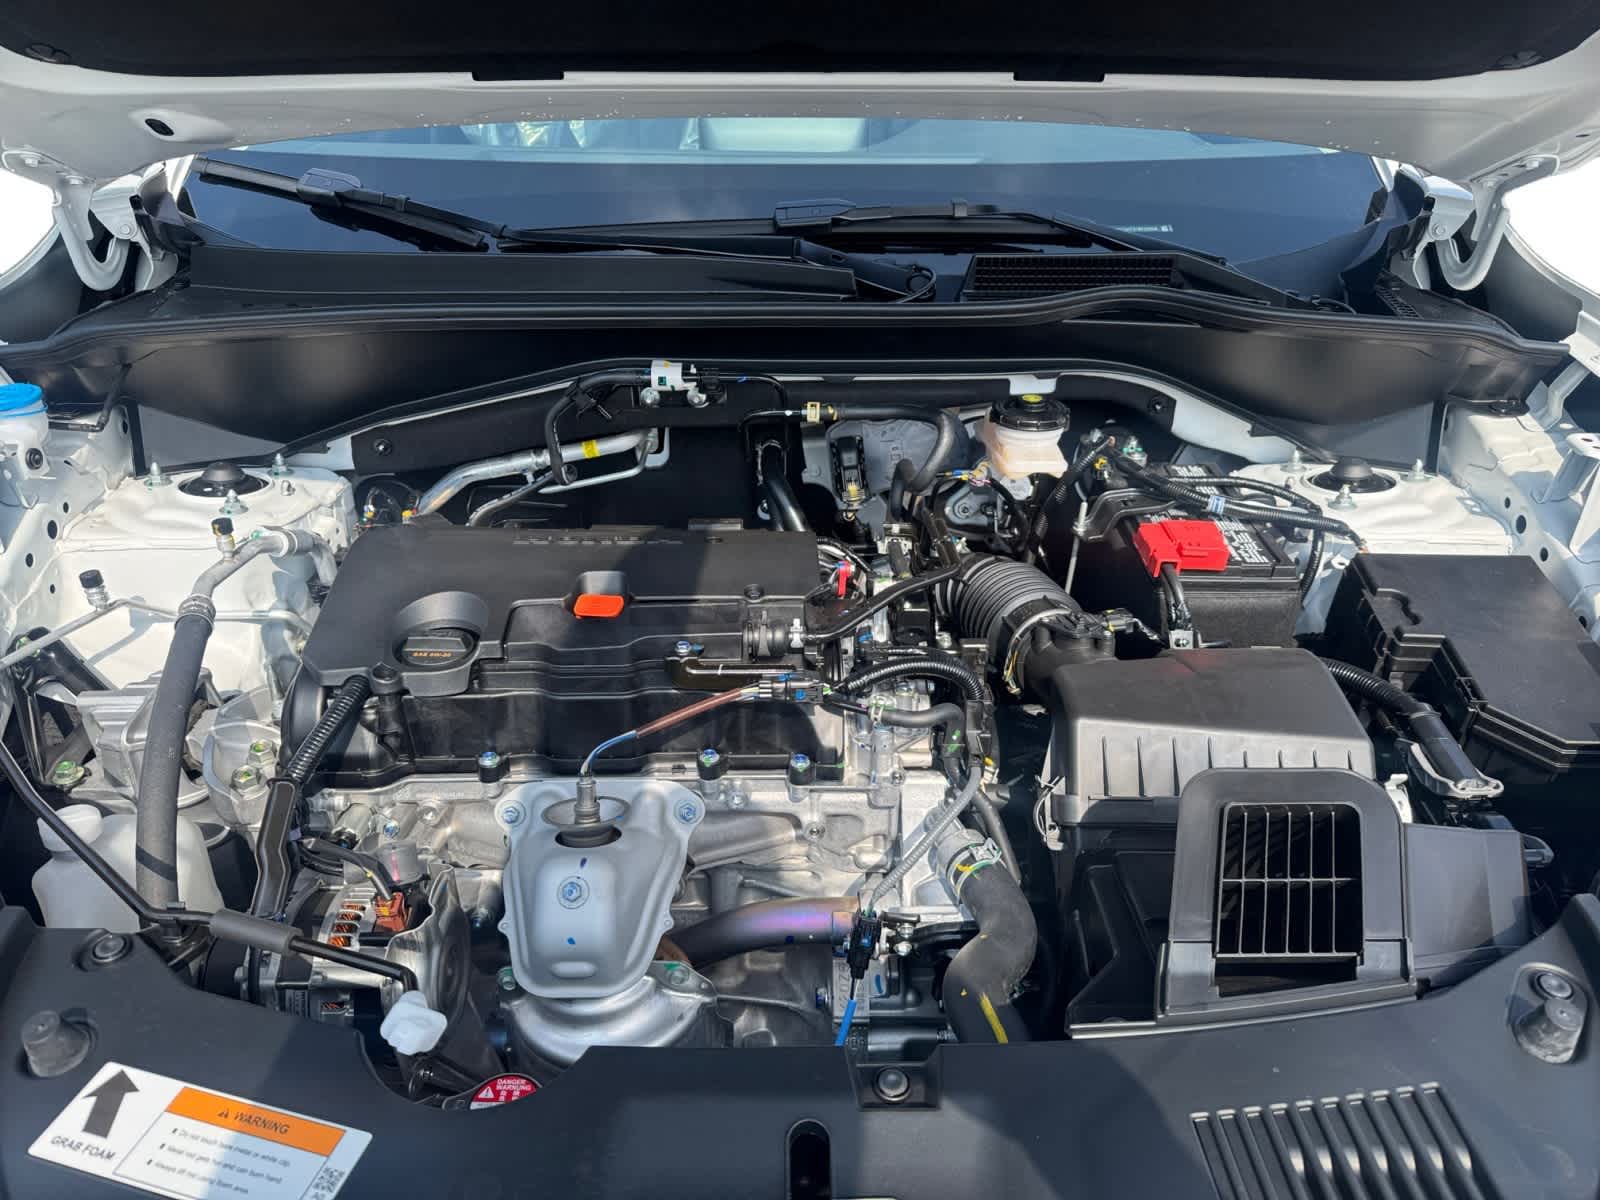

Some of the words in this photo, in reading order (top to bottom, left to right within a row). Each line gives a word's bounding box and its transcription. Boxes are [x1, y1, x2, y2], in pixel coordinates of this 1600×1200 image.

[233, 1111, 291, 1135] WARNING
[50, 1135, 82, 1152] GRAB
[82, 1144, 117, 1160] FOAM
